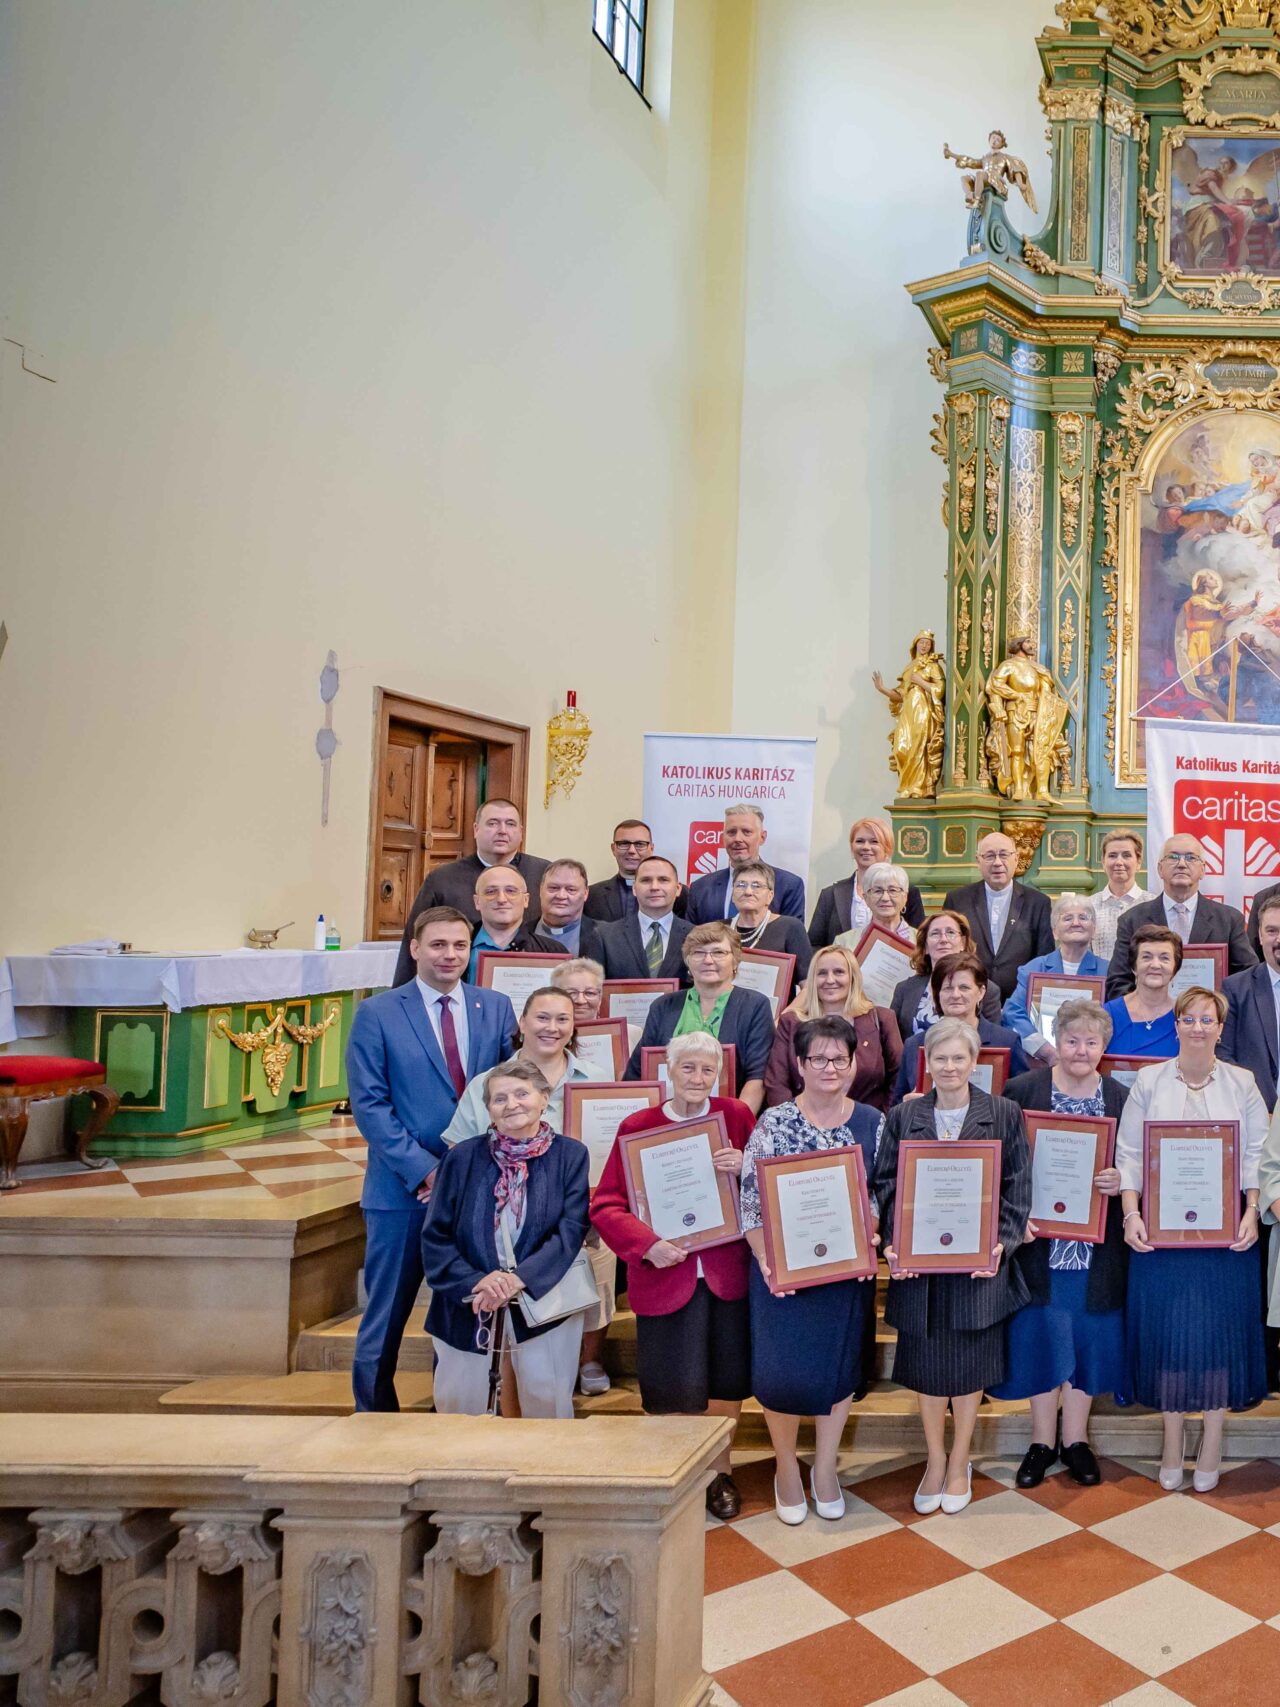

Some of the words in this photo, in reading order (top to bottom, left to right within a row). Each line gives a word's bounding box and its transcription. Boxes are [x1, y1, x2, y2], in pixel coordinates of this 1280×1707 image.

[1176, 756, 1237, 772] Katolikus
[662, 765, 731, 780] KATOLIKUS
[734, 765, 795, 782] KARITÁSZ
[668, 783, 715, 798] CARITAS
[718, 785, 786, 799] HUNGARICA
